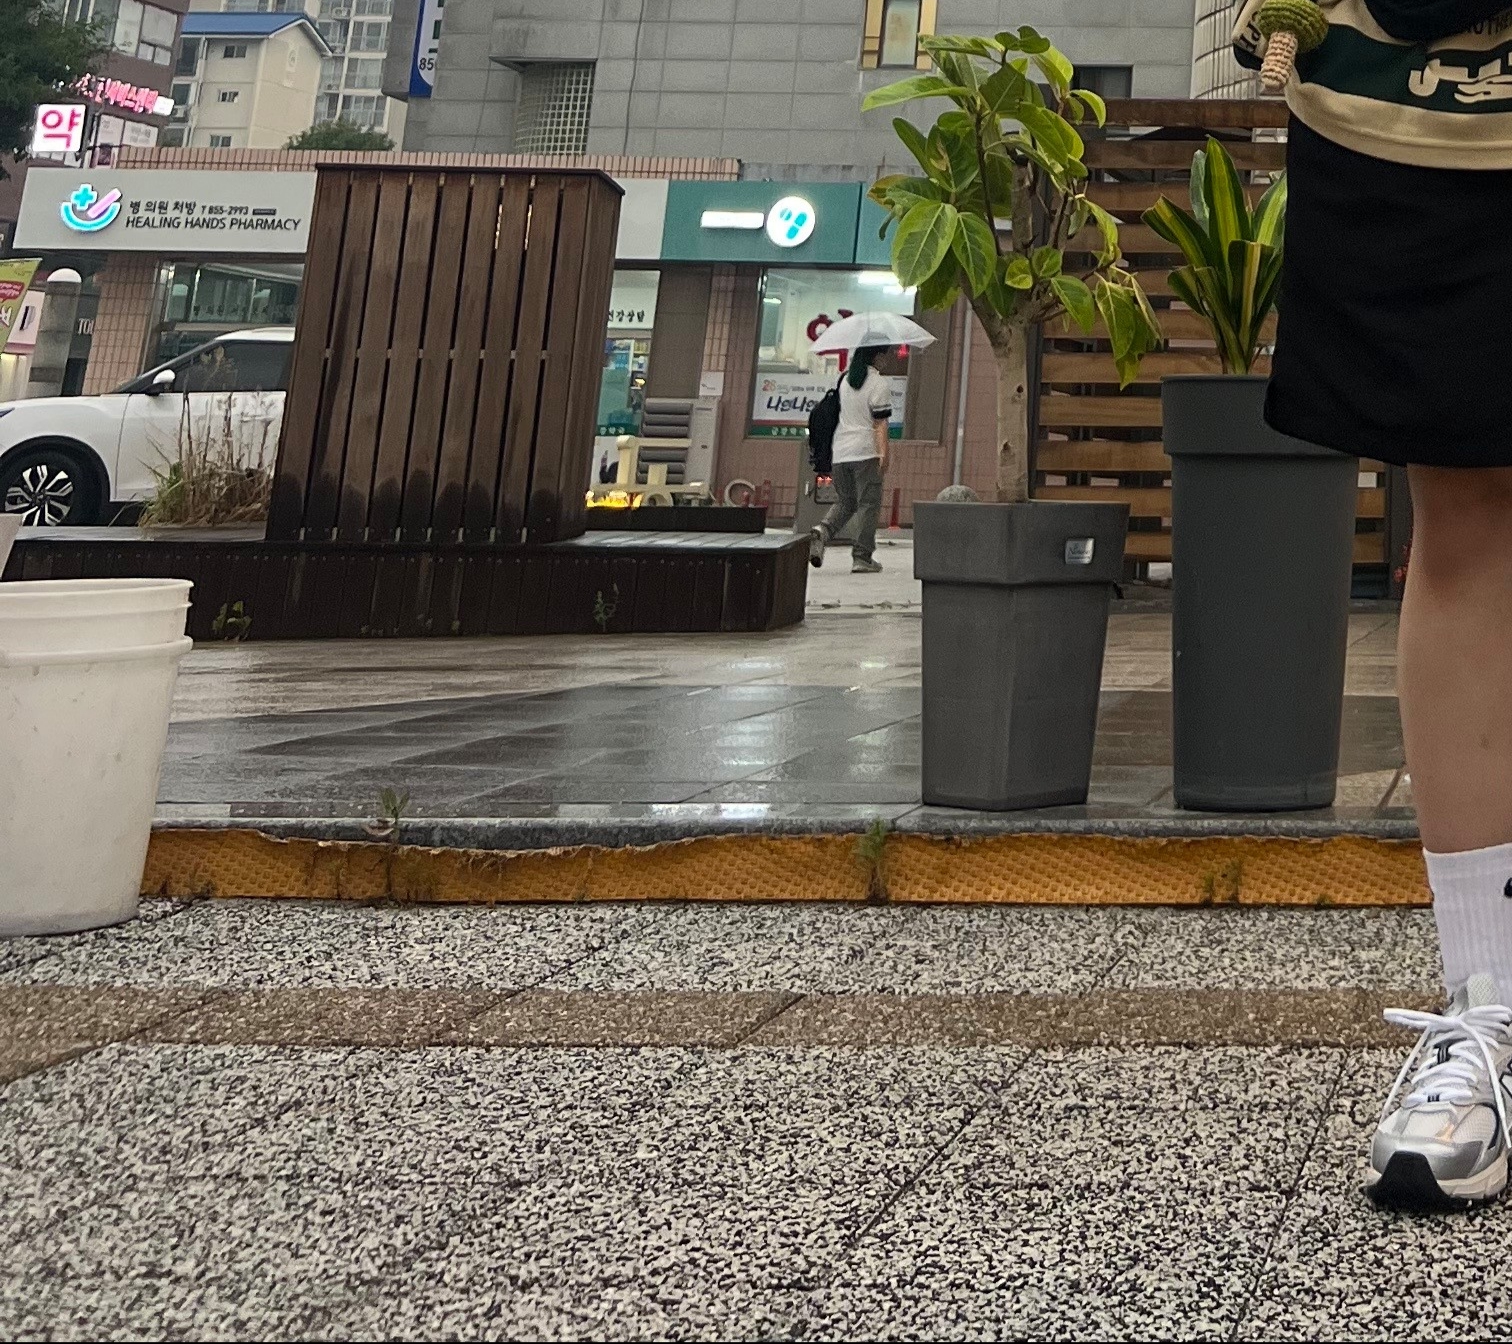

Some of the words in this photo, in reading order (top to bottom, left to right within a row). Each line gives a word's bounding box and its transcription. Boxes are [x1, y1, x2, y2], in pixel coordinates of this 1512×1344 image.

[41, 108, 82, 149] 약
[144, 201, 169, 215] 의원
[173, 201, 197, 216] 처방
[126, 216, 182, 229] HEALING
[184, 216, 226, 230] HANDS
[229, 216, 301, 231] PHARMACY
